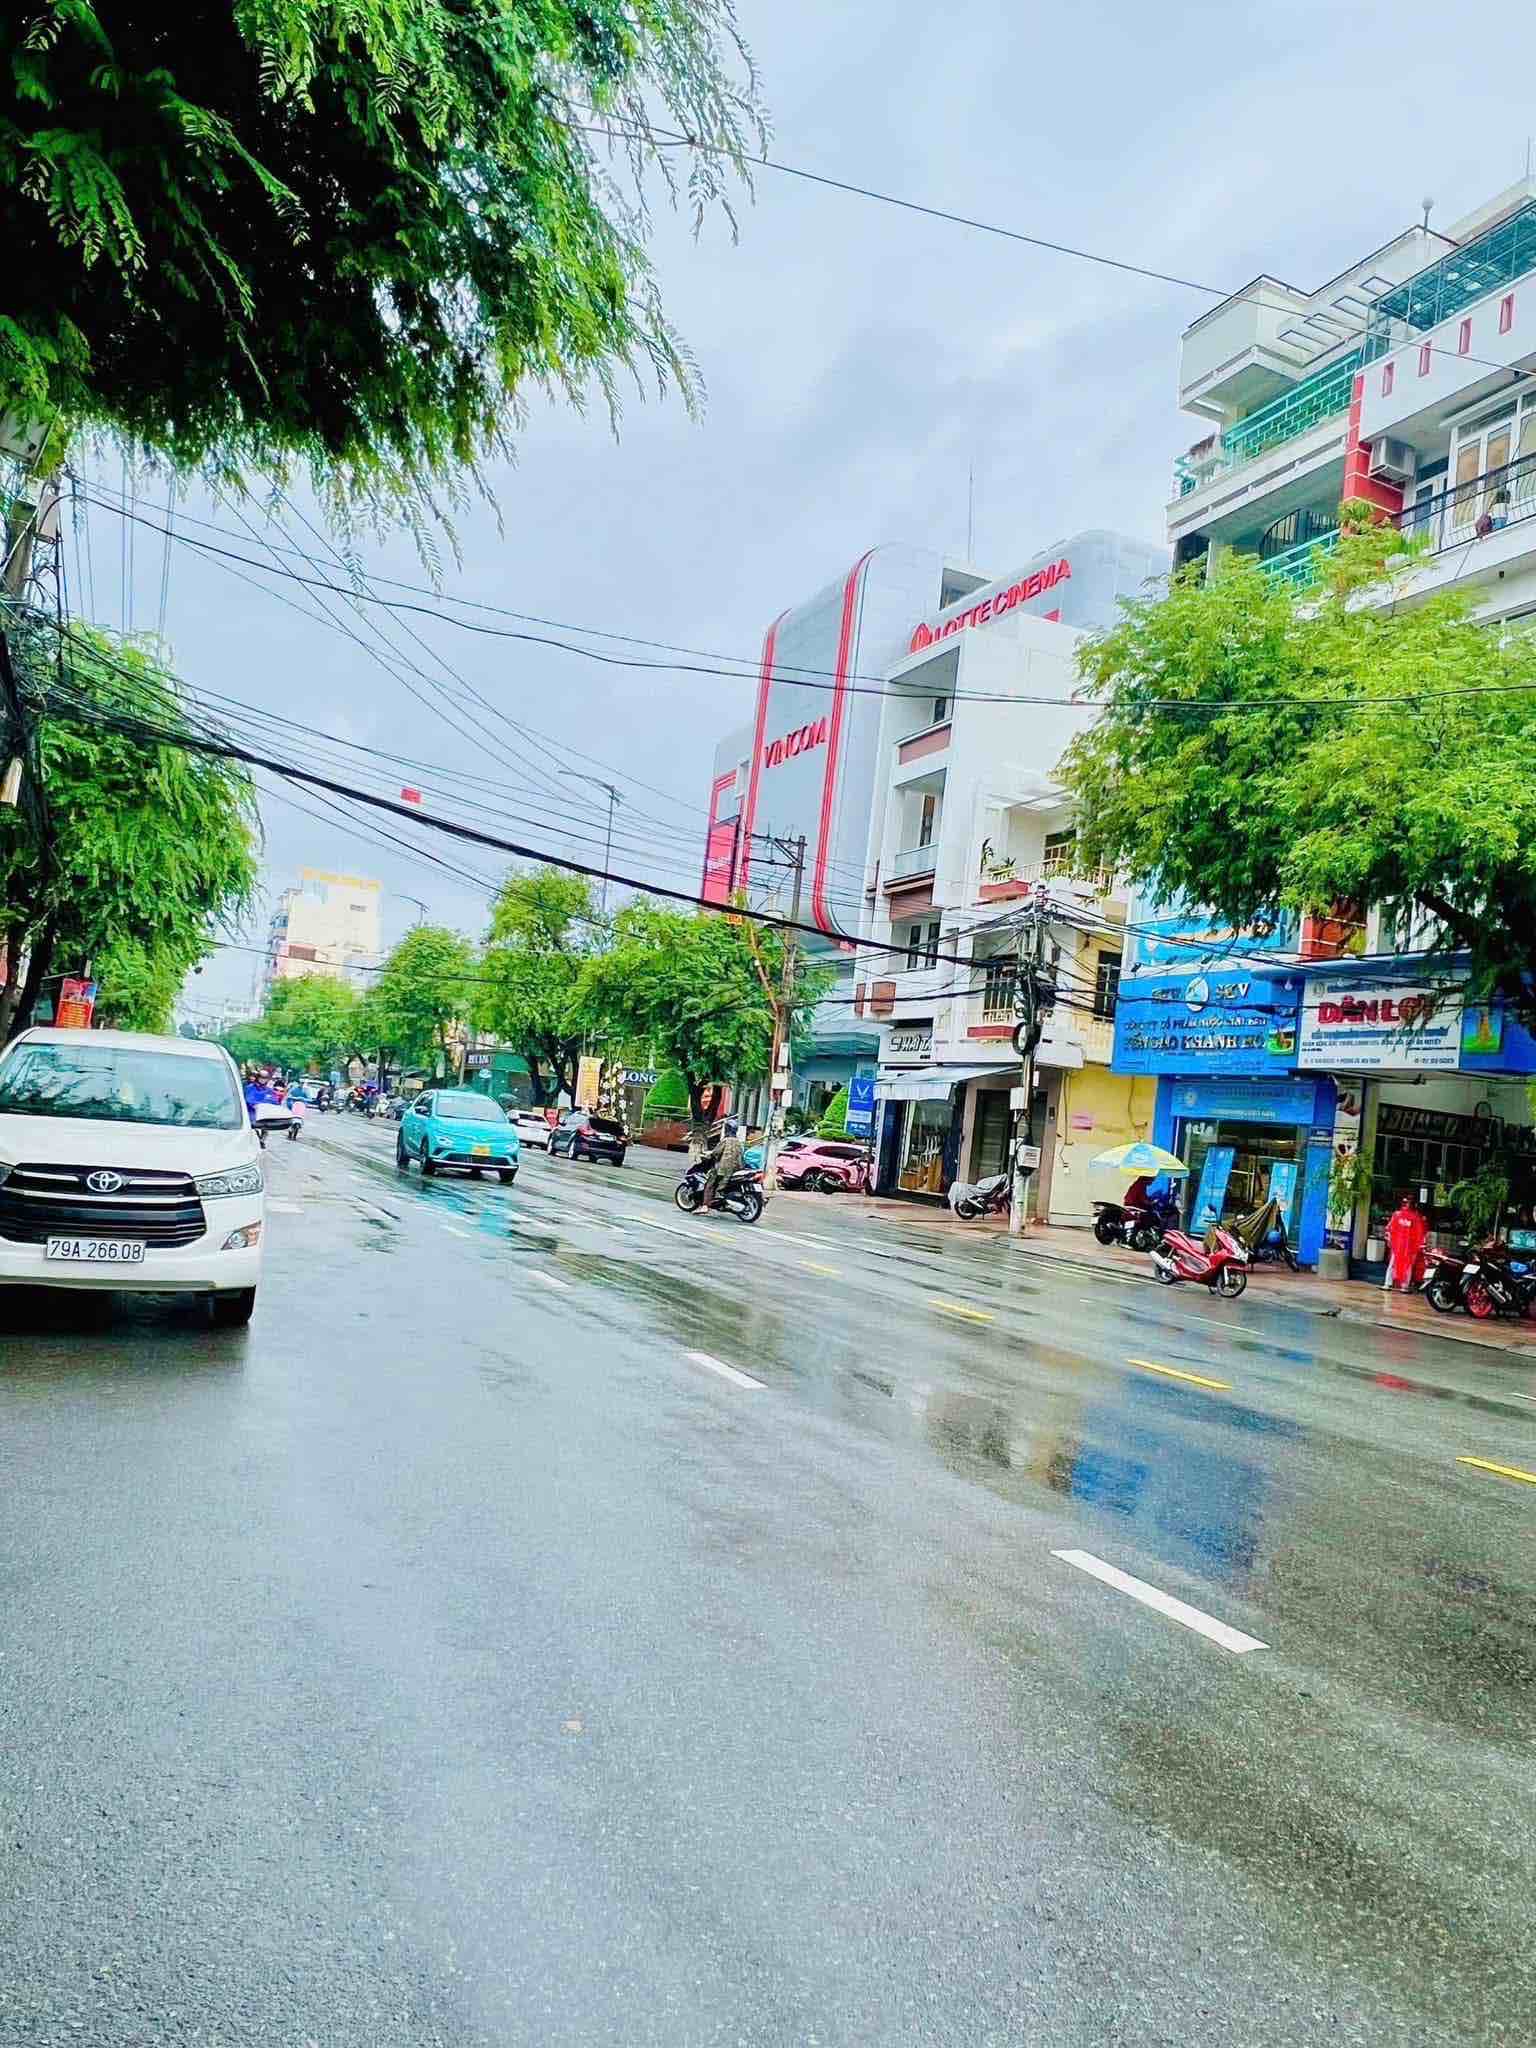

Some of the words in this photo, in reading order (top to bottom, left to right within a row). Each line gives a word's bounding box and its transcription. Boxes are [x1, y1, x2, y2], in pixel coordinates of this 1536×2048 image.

[932, 599, 992, 641] LOTTE
[992, 558, 1072, 616] CINEMA
[764, 715, 827, 769] VINCOM
